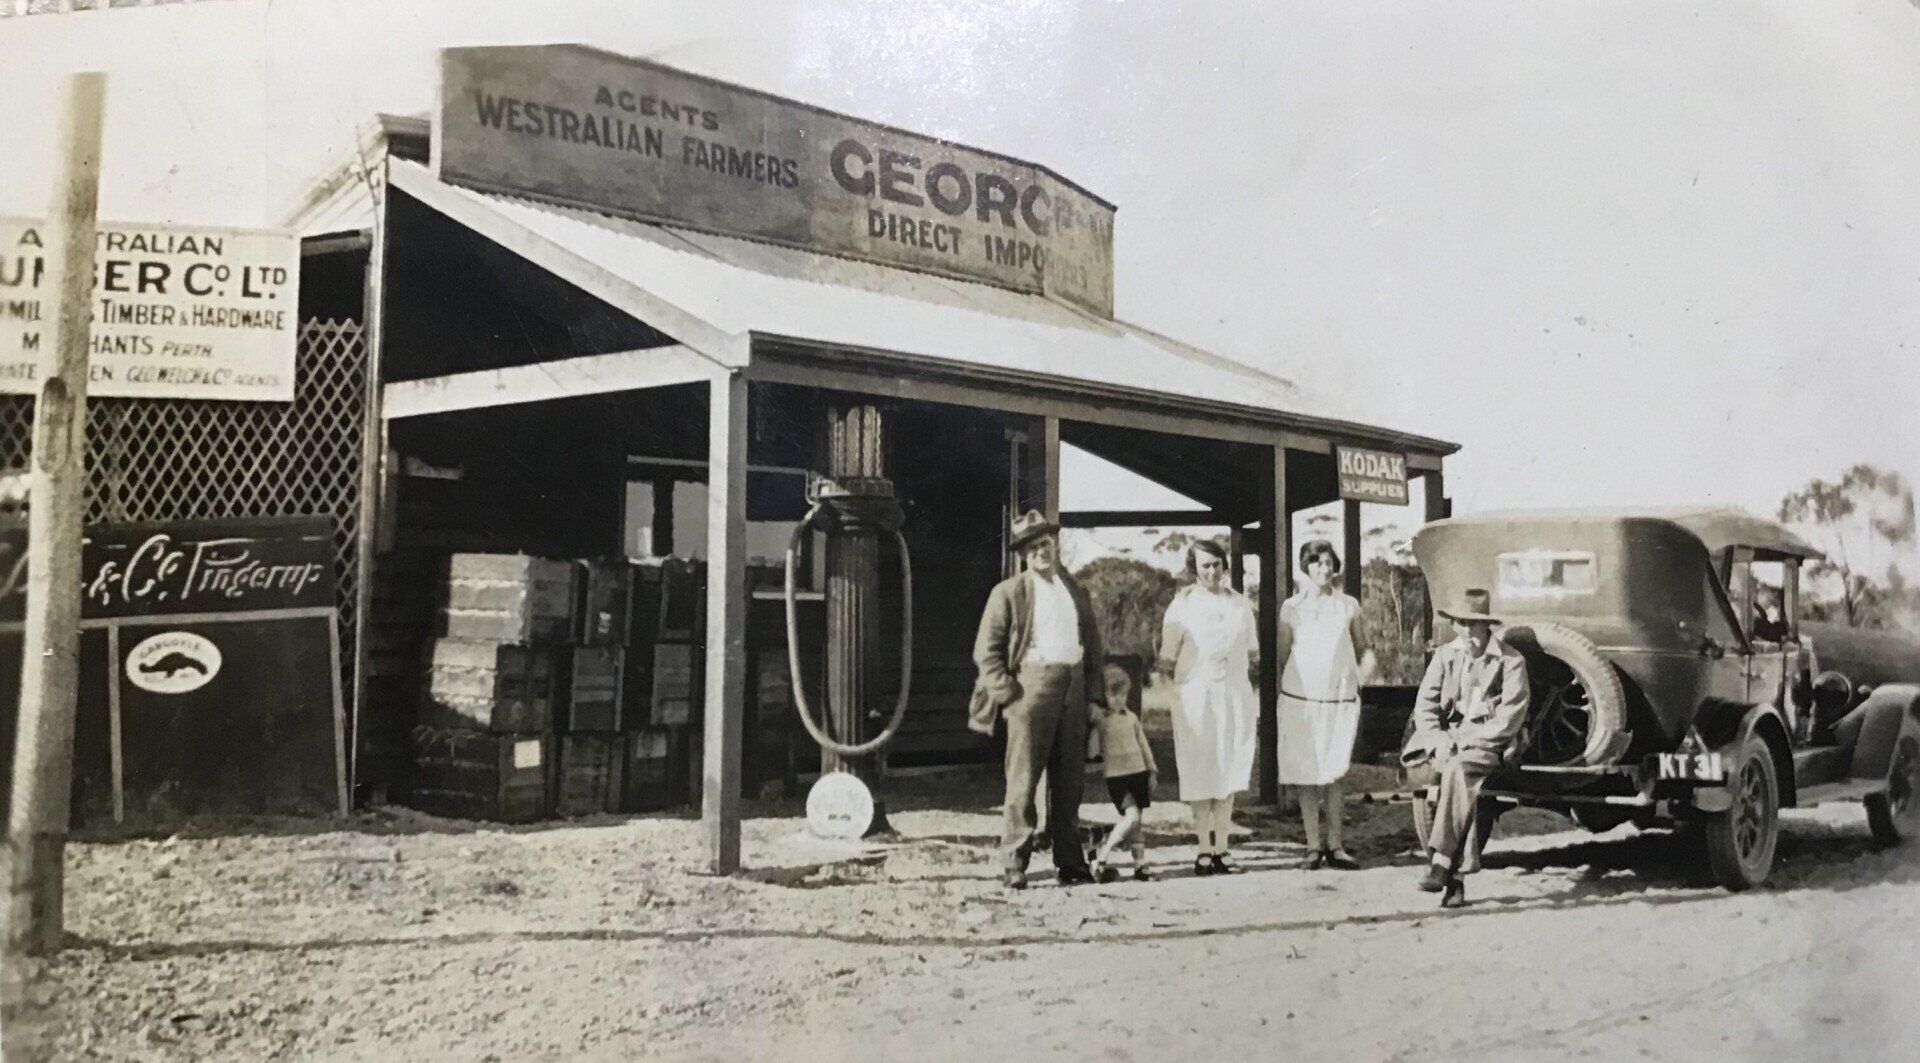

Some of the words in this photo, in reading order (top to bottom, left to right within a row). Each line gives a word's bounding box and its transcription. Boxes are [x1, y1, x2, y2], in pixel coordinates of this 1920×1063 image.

[594, 85, 720, 132] AGENTS
[474, 90, 664, 160] WESTRALIAN
[681, 134, 800, 189] FARMERS
[868, 207, 962, 255] DIRECT
[101, 298, 176, 325] TIMBER
[192, 303, 285, 331] HARDWARE
[160, 340, 214, 358] PERTH
[1340, 450, 1404, 482] KODAK
[1658, 752, 1689, 780] KT
[1693, 752, 1723, 782] 31
